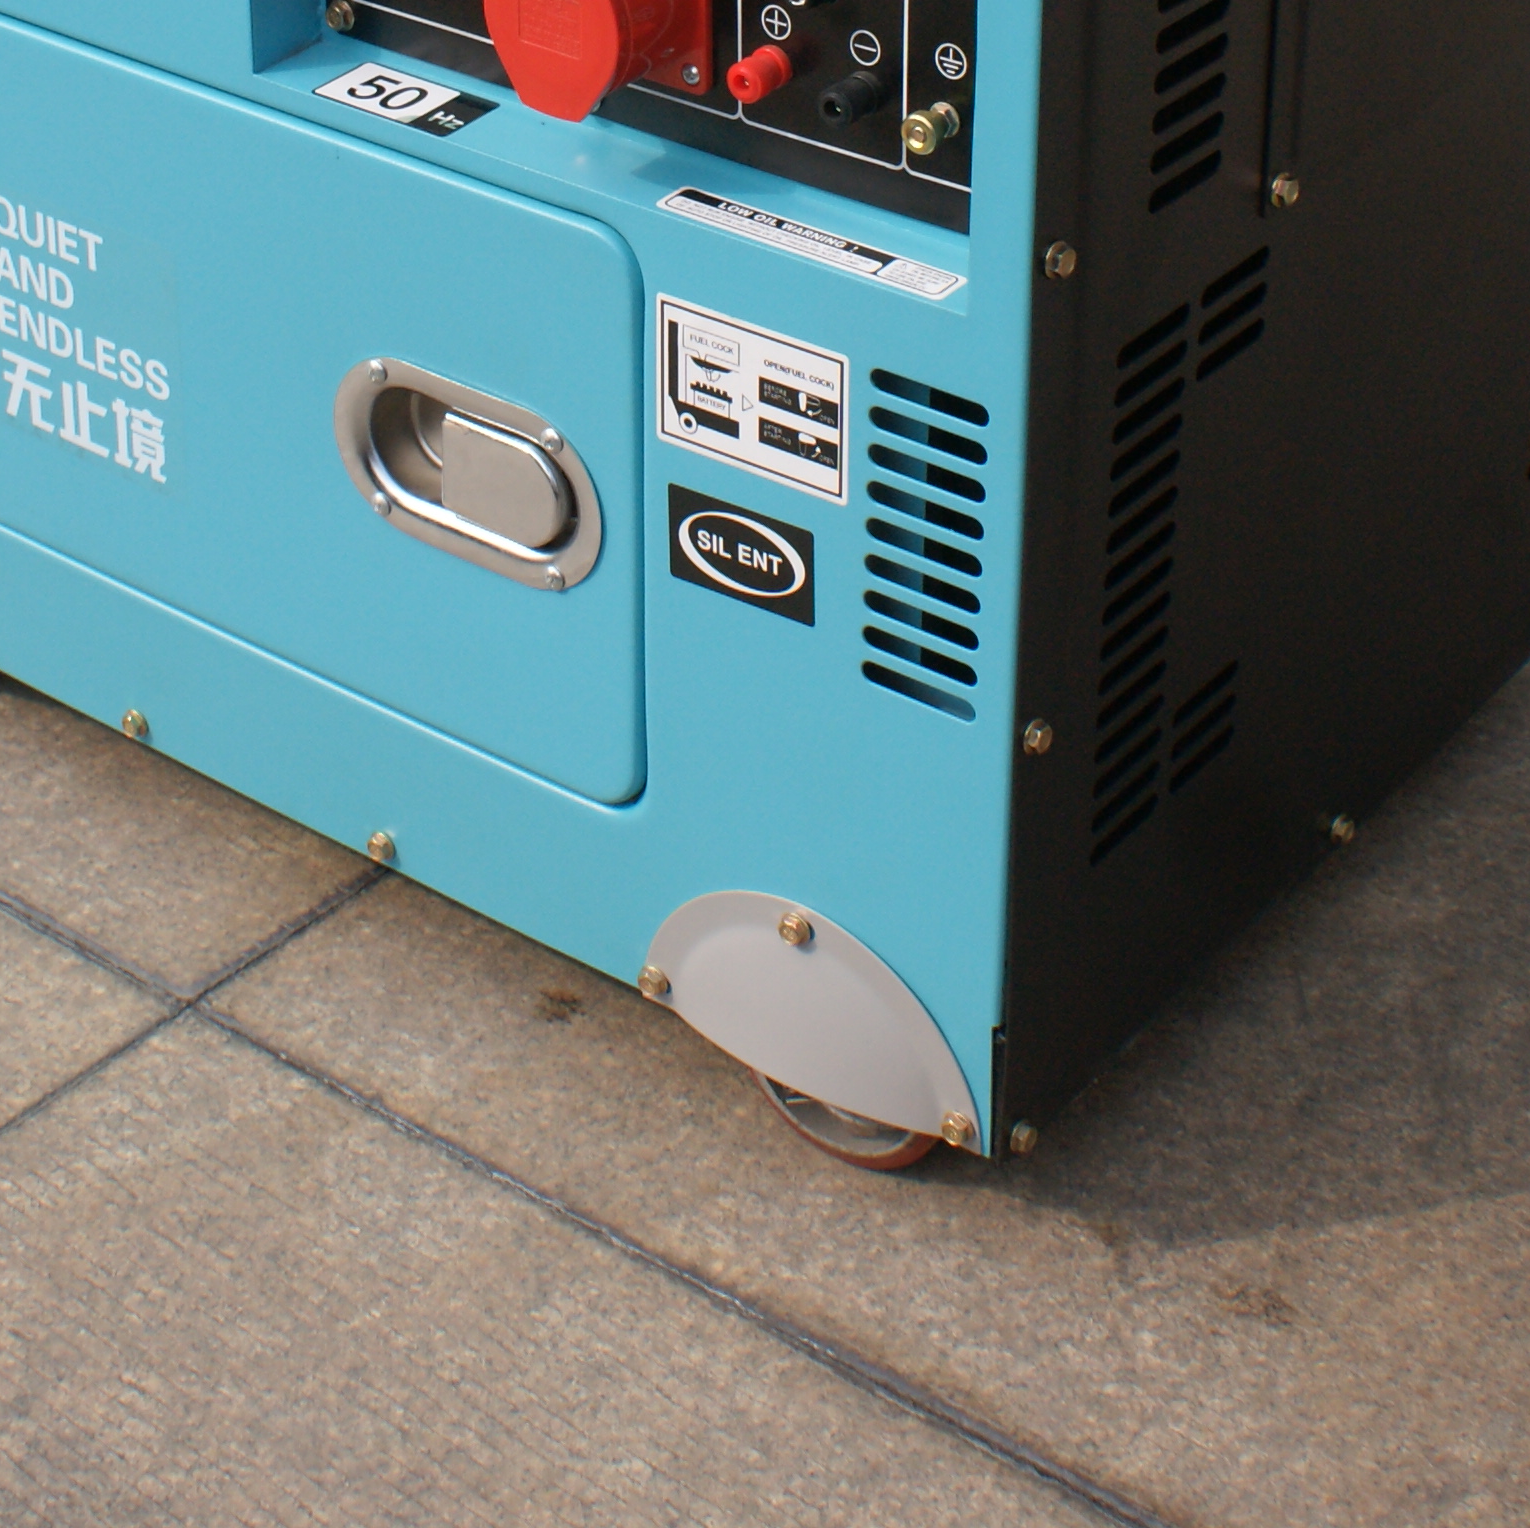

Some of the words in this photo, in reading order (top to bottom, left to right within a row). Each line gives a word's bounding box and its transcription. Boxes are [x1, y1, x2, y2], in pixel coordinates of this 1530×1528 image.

[346, 75, 428, 110] 50
[428, 111, 465, 130] Hz
[718, 201, 752, 217] LOW
[753, 212, 778, 227] OIL
[781, 221, 848, 250] WARNING
[689, 333, 710, 348] FUEL
[711, 340, 734, 355] COCK
[1, 348, 167, 484] 无止境
[697, 394, 726, 411] BATTERY
